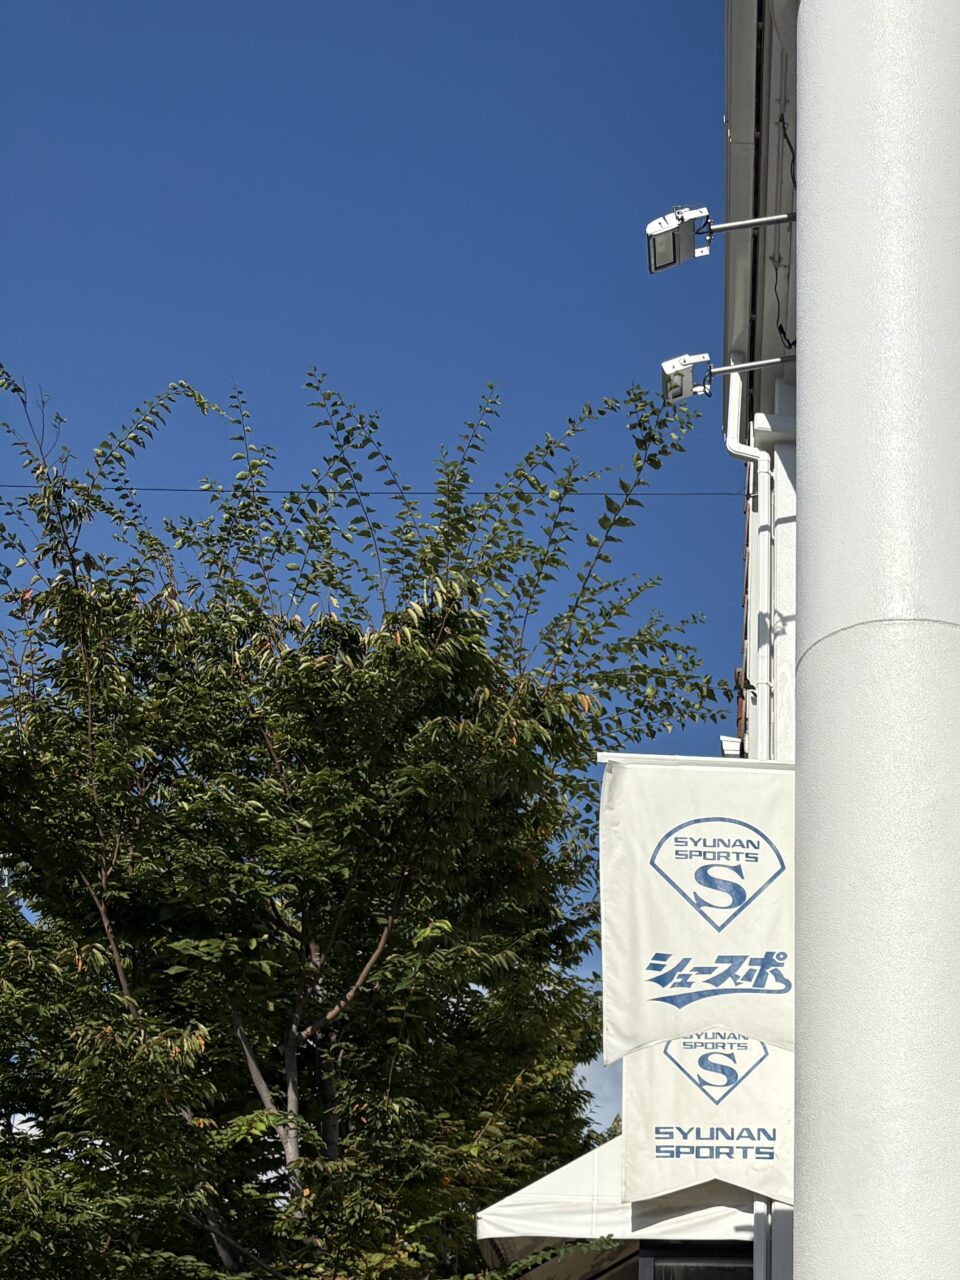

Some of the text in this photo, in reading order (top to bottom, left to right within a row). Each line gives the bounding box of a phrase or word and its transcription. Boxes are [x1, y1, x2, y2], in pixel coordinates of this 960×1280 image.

[673, 836, 761, 850] SYUNAN
[674, 849, 759, 863] SPORTS
[693, 864, 747, 910] S
[645, 951, 792, 991] シュースポ
[682, 1041, 748, 1050] SPORTS
[696, 1051, 739, 1088] S
[654, 1126, 777, 1142] SYUNAN
[655, 1145, 776, 1161] SPORTS
